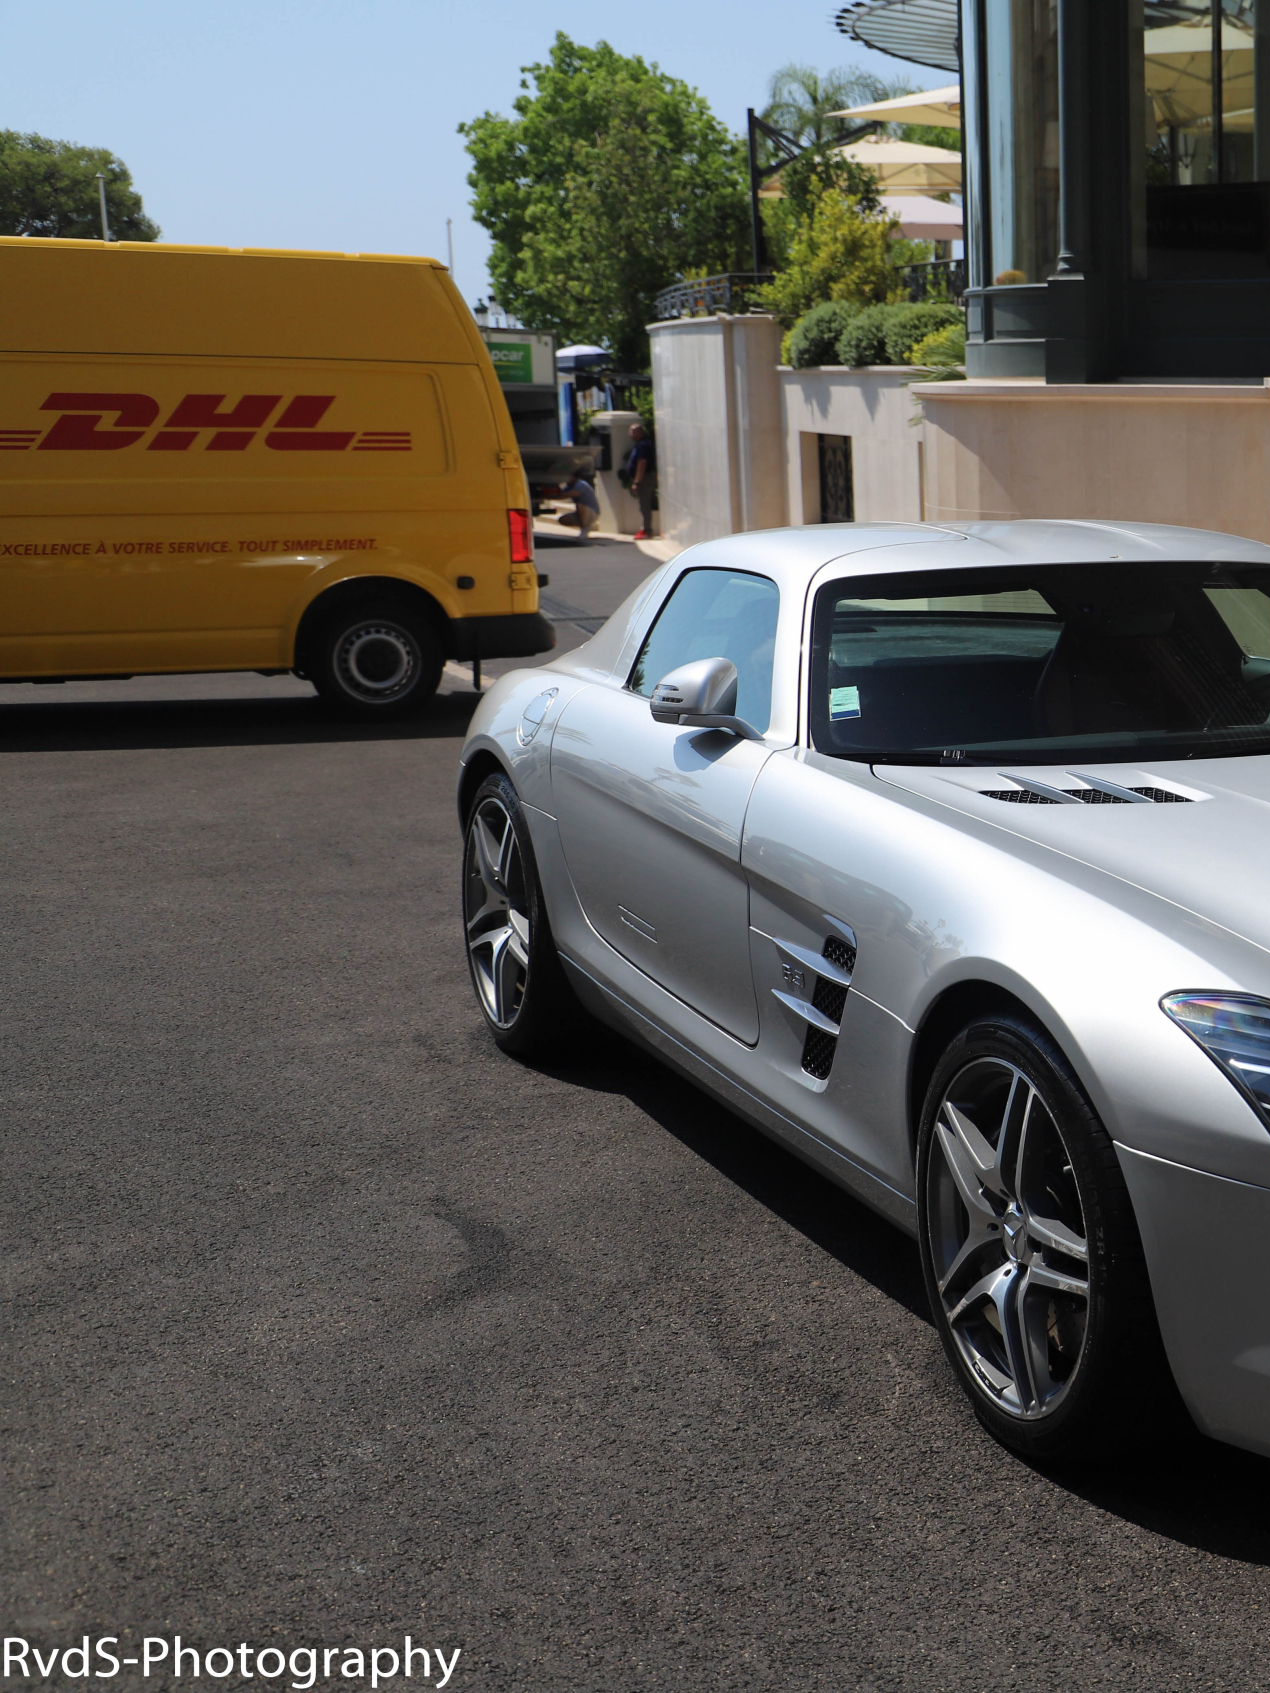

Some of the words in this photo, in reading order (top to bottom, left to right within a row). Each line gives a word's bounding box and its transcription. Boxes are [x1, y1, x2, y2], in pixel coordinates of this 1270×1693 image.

[491, 350, 525, 364] pcar
[37, 393, 357, 451] DHL
[0, 543, 91, 556] XCELLENCE
[95, 540, 107, 555] À
[112, 542, 164, 555] VOTRE
[168, 541, 232, 554] SERVICE.
[238, 540, 280, 553] TOUT
[282, 538, 379, 552] SIMPLEMENT.
